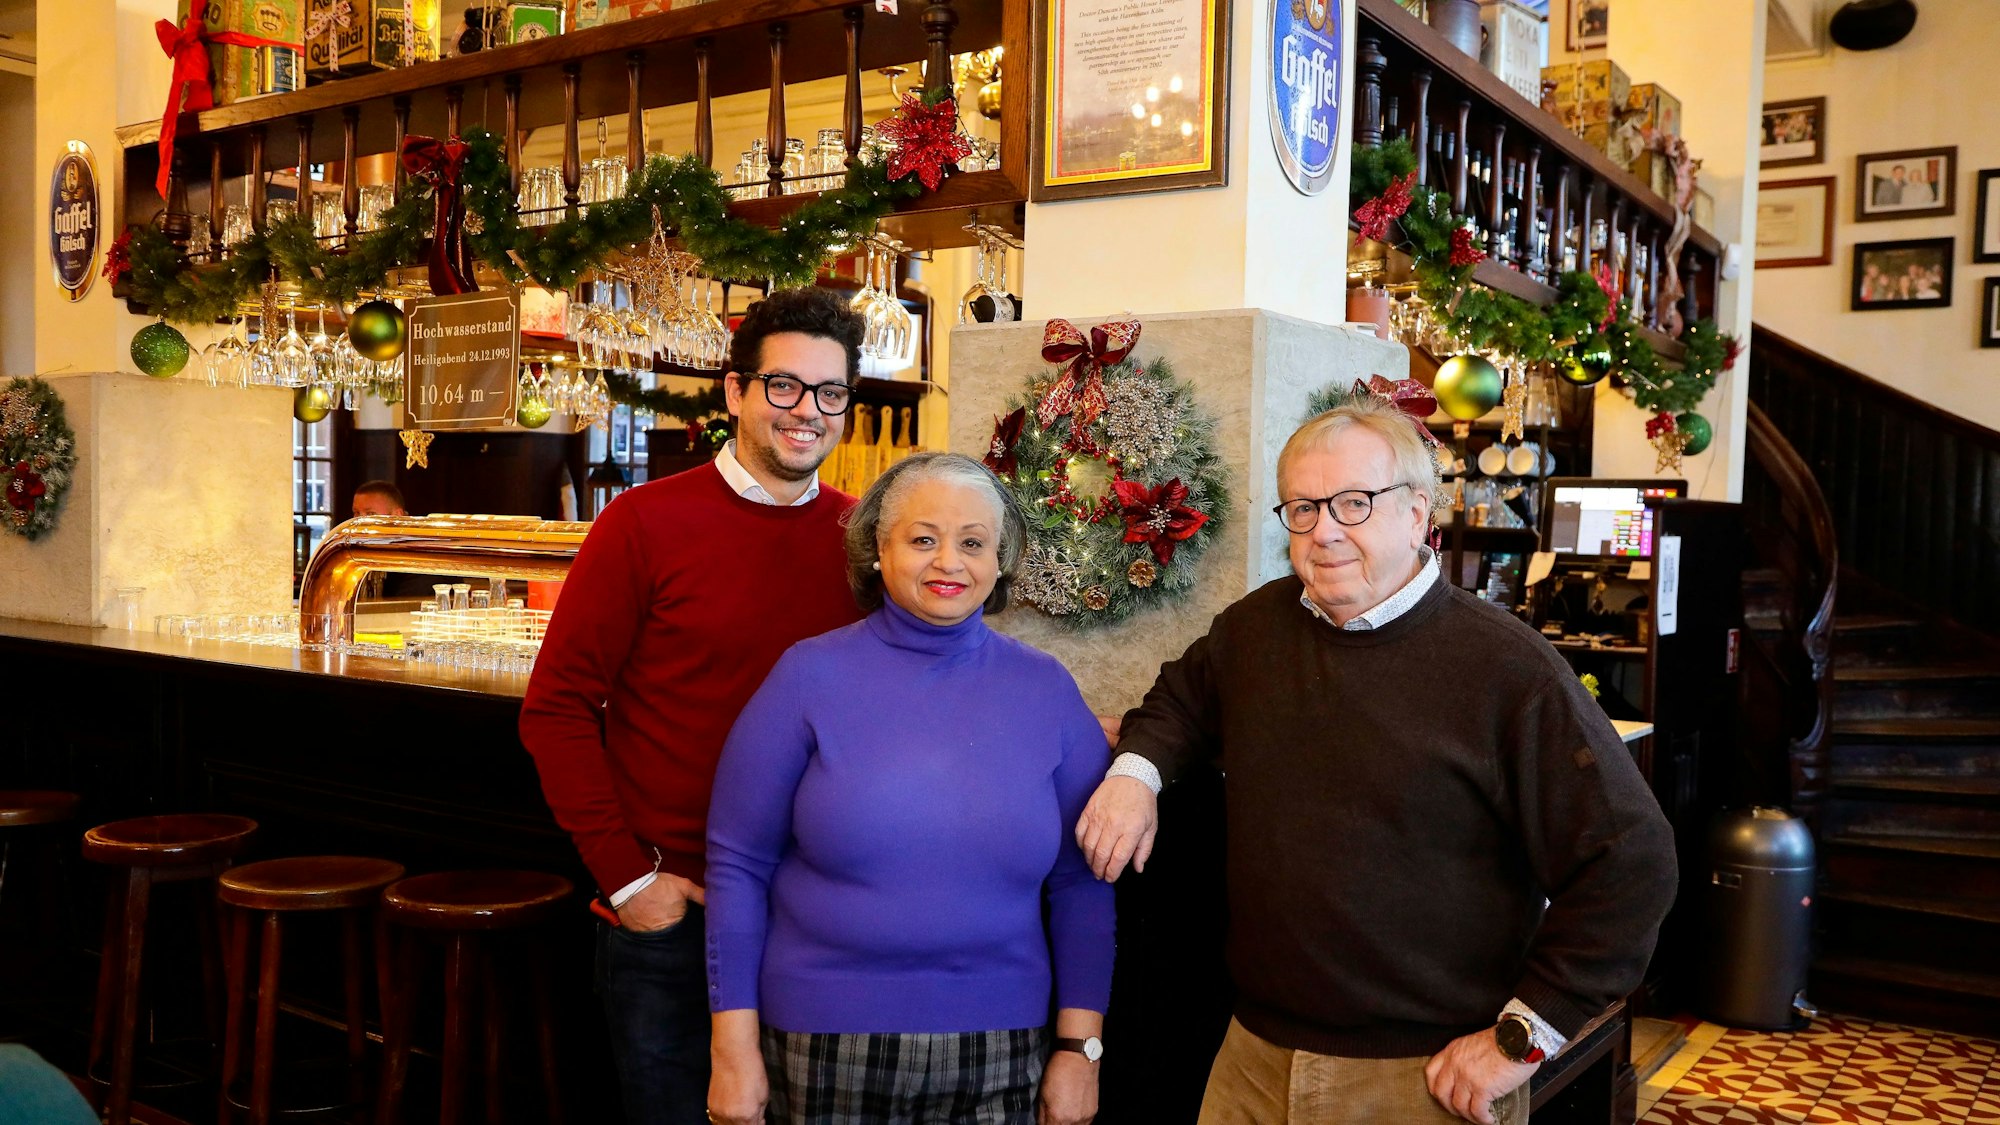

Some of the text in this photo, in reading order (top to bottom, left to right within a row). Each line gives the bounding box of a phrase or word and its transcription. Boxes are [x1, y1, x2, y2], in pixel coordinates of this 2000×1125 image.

[1098, 15, 1109, 23] with
[1146, 29, 1172, 37] respective
[311, 24, 364, 66] Qulität
[1078, 47, 1111, 56] strengthening
[1083, 52, 1119, 63] demonstrating
[1129, 46, 1161, 55] commitment
[1089, 62, 1118, 71] partnership
[1136, 54, 1160, 63] approach
[1110, 66, 1141, 75] anniversary
[1149, 61, 1163, 69] 2002
[1282, 34, 1336, 109] Gaffel
[55, 201, 92, 235] Gaffel
[60, 233, 86, 253] Kölsch
[413, 315, 512, 340] Hochwasserstand
[414, 347, 510, 367] Heiligabend 24.12.1993
[420, 383, 484, 407] 10,64 m
